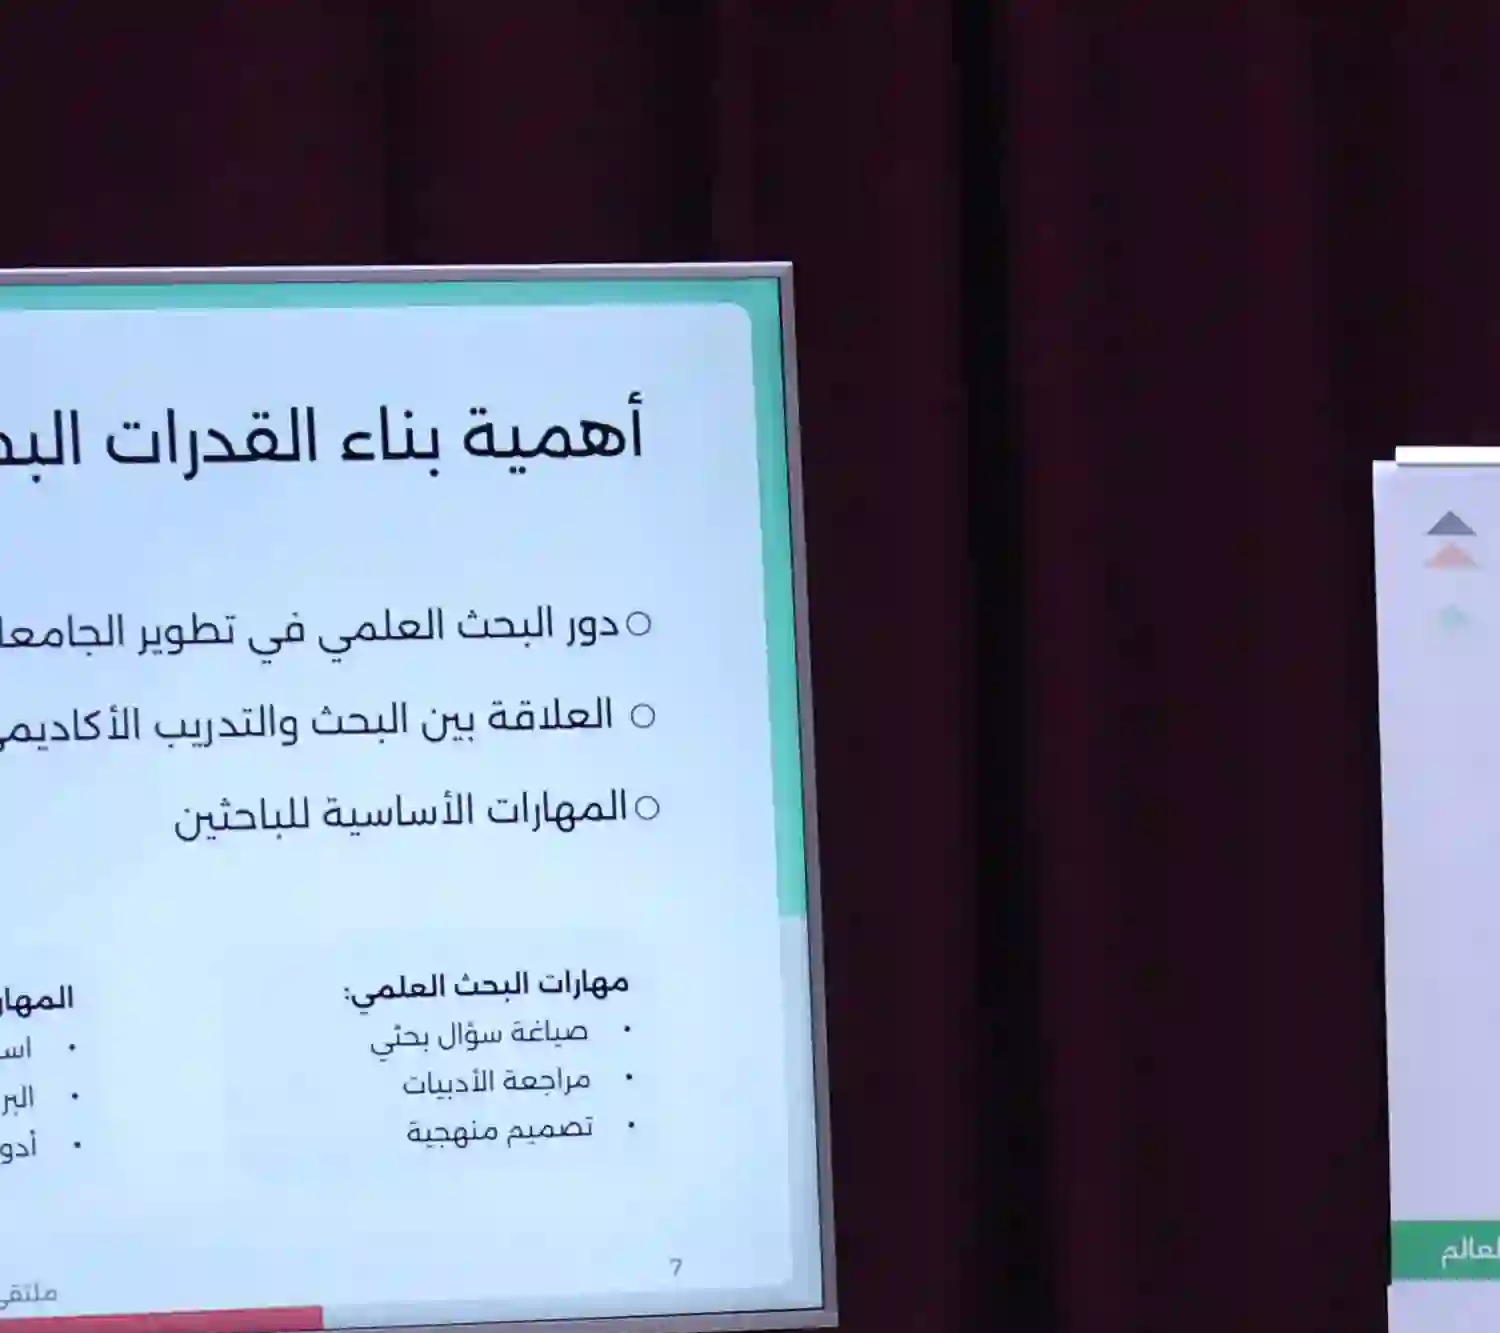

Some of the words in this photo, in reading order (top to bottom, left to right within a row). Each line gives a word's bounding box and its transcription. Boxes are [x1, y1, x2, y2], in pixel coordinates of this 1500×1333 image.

[105, 406, 315, 481] القدرات
[341, 405, 441, 477] بناء
[463, 391, 644, 477] أهمية
[0, 614, 124, 656] الجامعا
[137, 613, 237, 657] تطوير
[248, 613, 306, 666] في
[319, 607, 443, 664] العلمي
[457, 604, 553, 649] البحث
[566, 612, 619, 647] دور
[154, 704, 299, 747] والتدريب
[312, 700, 406, 738] البحث
[421, 704, 476, 742] بين
[488, 696, 612, 732] العلاقة
[174, 795, 310, 842] للباحثين
[323, 793, 474, 838] الأساسية
[487, 789, 626, 832] المهارات
[0, 985, 74, 1018] المها
[453, 972, 528, 998] البحث
[538, 970, 629, 998] مهارات
[370, 1025, 430, 1061] بحثي
[438, 1021, 503, 1050] سؤال
[511, 1018, 589, 1046] صياغة
[402, 1067, 495, 1100] الأدبيات
[503, 1067, 590, 1094] مراجعة
[2, 1085, 34, 1117] البر
[0, 1130, 37, 1165] أدو
[406, 1119, 498, 1149] منهجية
[506, 1116, 593, 1149] تصميم
[669, 1258, 683, 1279] 7
